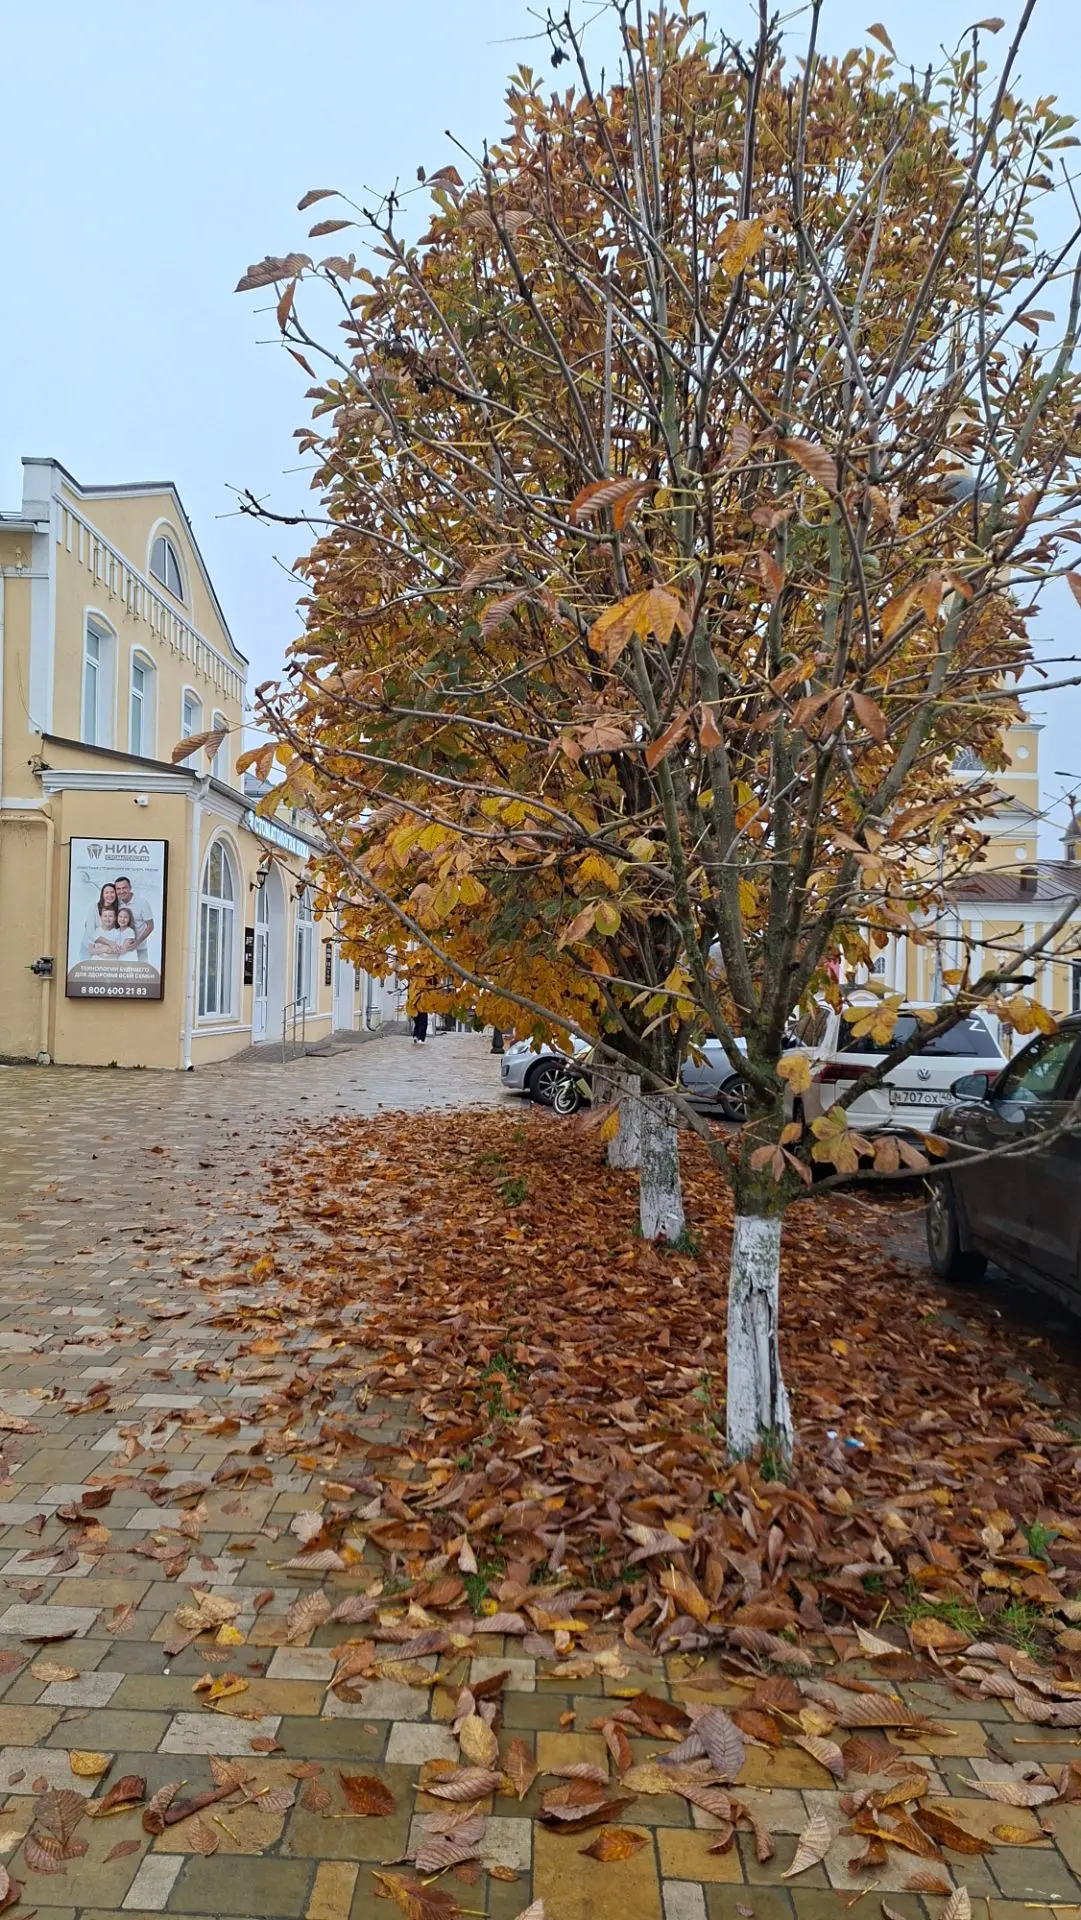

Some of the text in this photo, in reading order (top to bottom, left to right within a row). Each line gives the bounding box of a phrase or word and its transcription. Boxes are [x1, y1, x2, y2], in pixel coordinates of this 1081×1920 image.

[105, 844, 150, 855] НИКА
[81, 986, 87, 994] 8
[88, 986, 106, 994] 800
[107, 987, 124, 995] 600
[136, 988, 147, 996] 83
